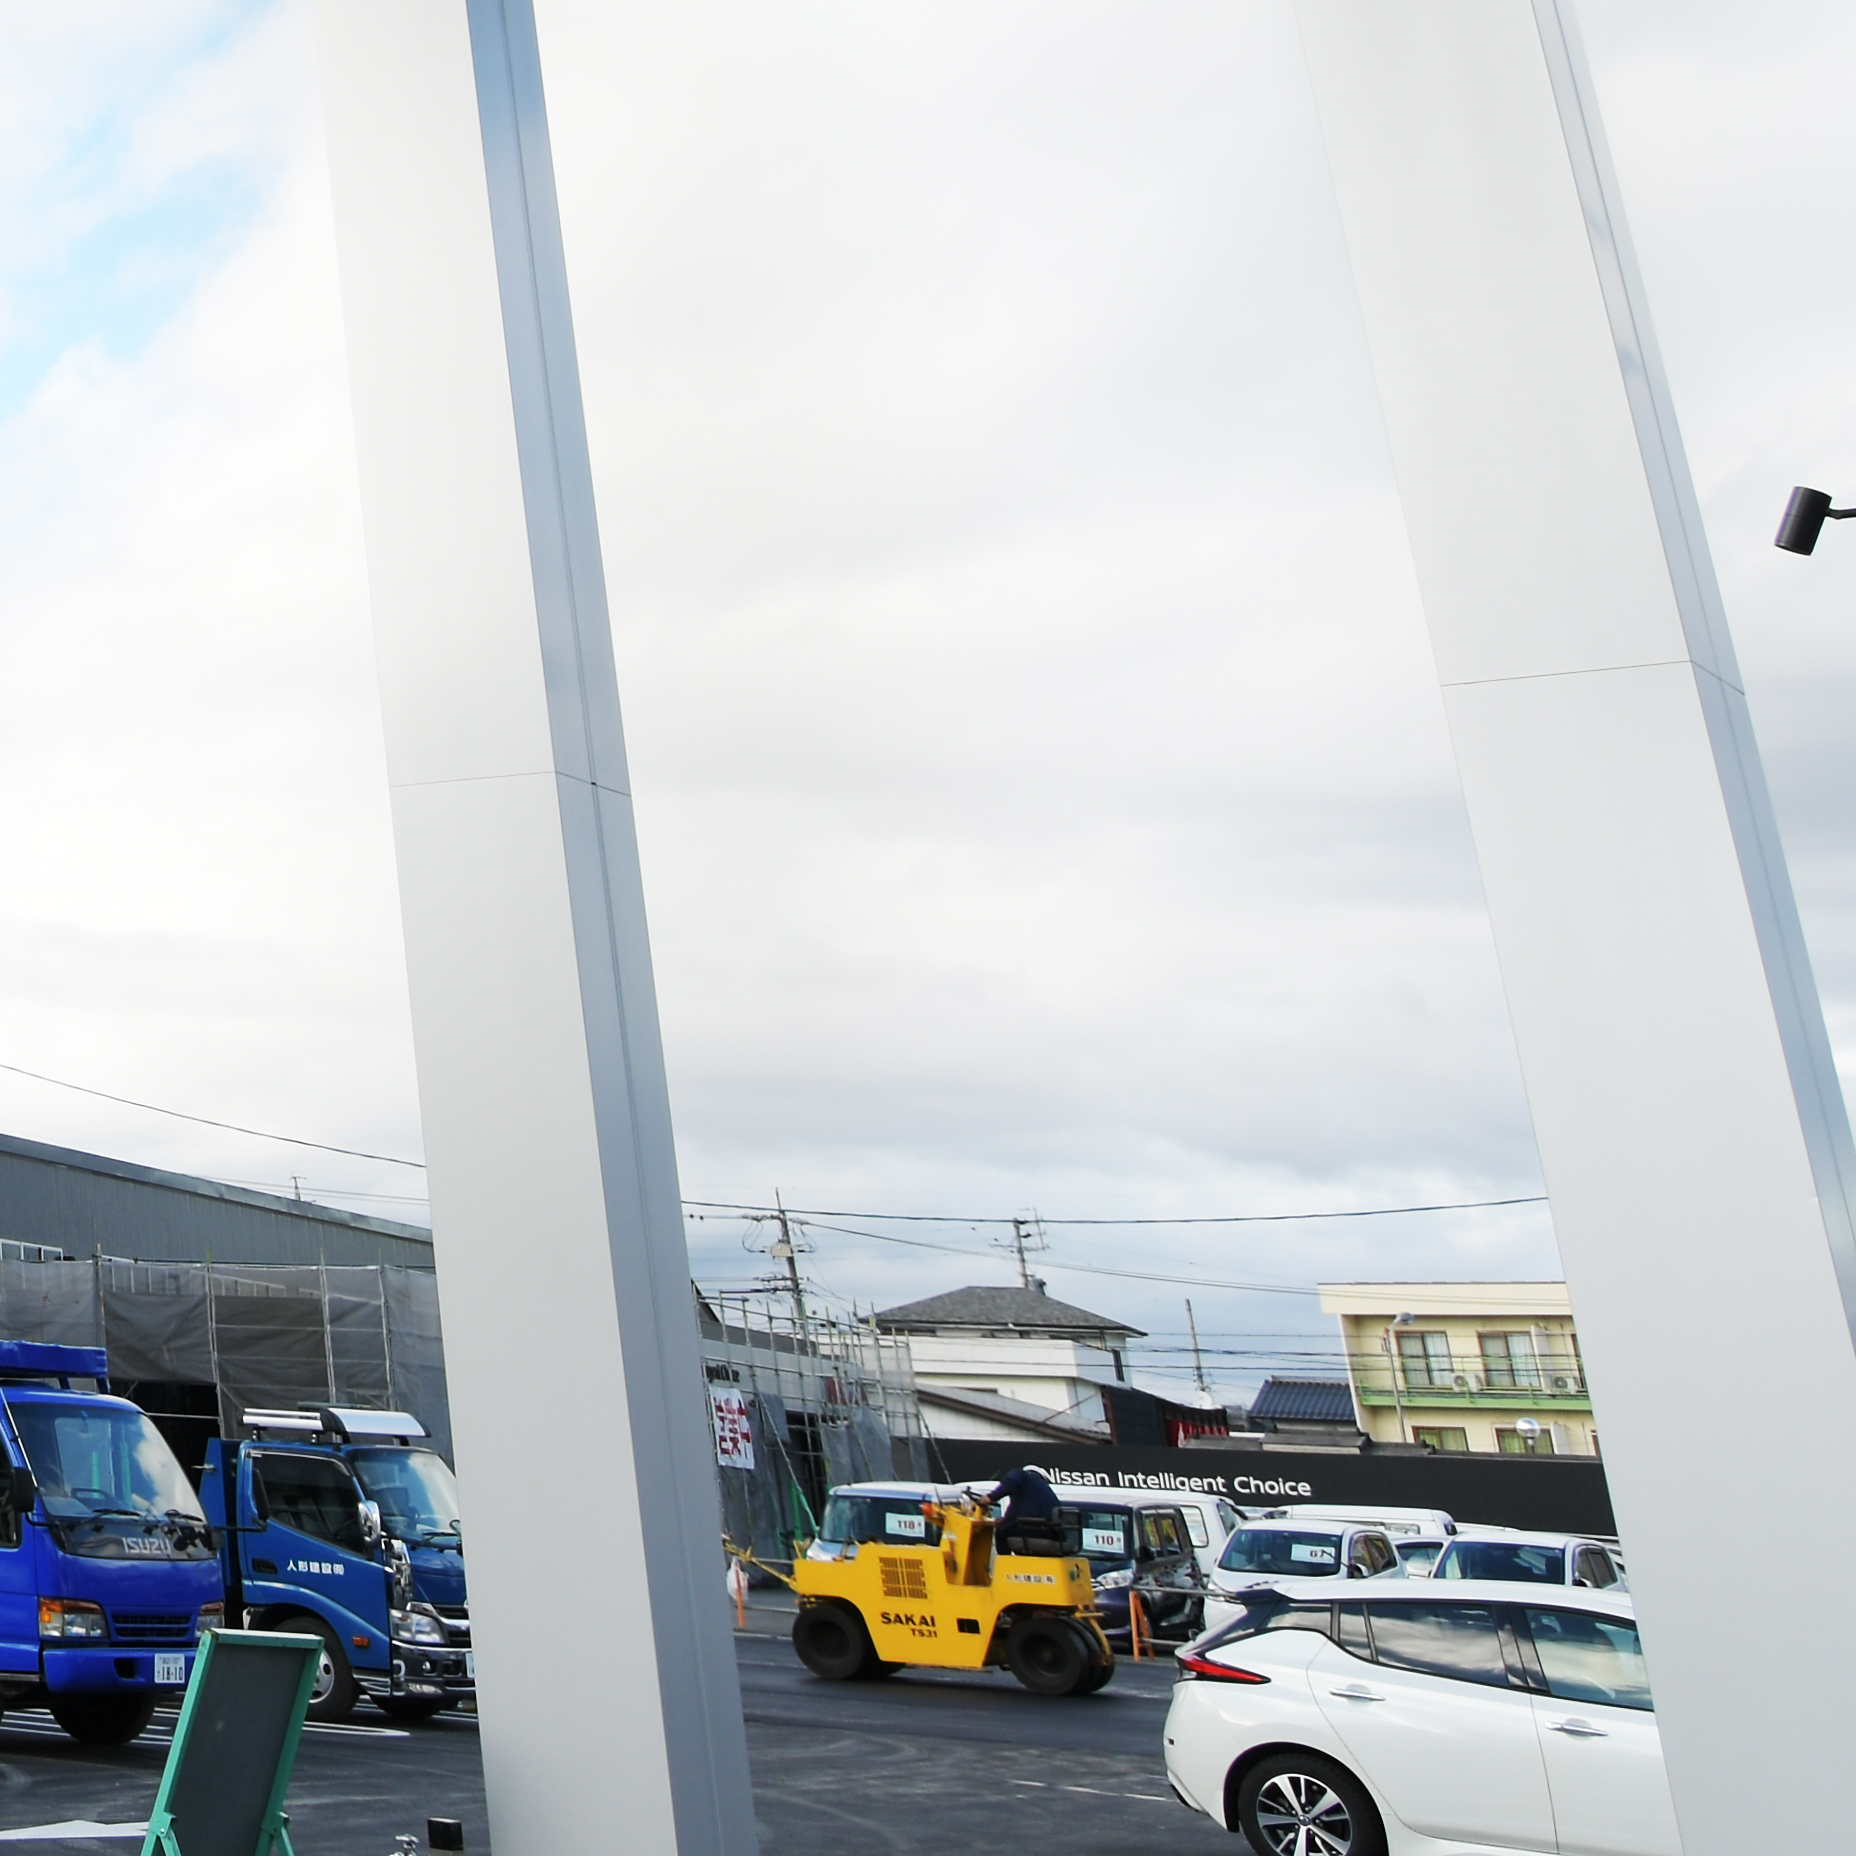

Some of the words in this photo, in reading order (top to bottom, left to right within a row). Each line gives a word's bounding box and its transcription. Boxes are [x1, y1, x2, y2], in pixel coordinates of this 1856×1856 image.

[1118, 1471, 1228, 1493] Intelligent
[1234, 1476, 1312, 1497] Choice
[121, 1536, 172, 1554] ISUZU
[1095, 1535, 1114, 1546] 110
[880, 1611, 936, 1628] SAKAI
